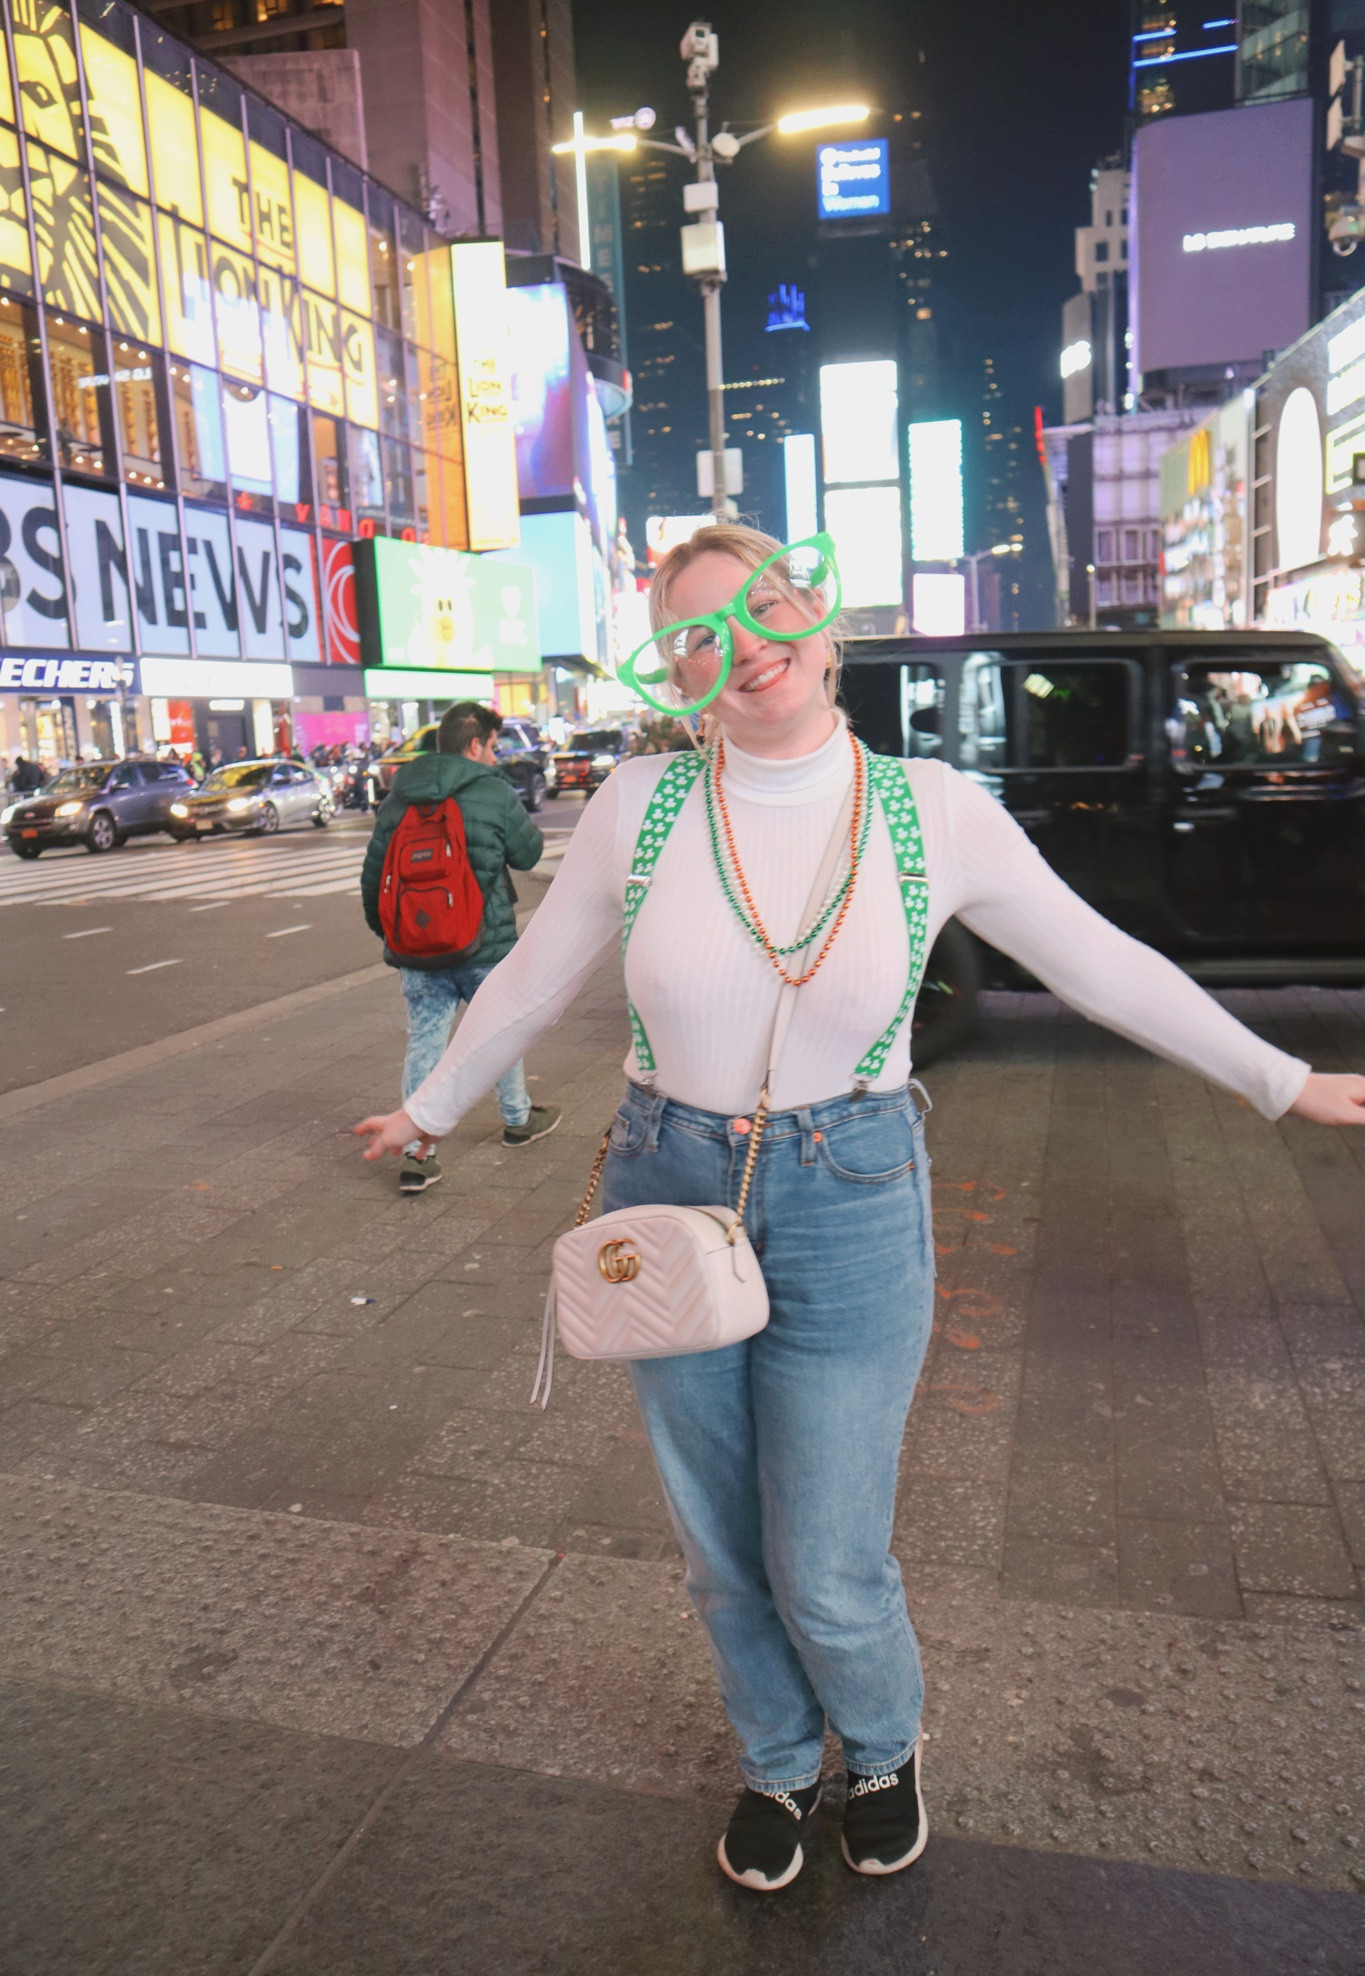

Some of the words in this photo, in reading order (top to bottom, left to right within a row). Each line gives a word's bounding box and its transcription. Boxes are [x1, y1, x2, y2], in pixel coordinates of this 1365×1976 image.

[232, 176, 292, 251] THE
[170, 203, 272, 331] LION
[277, 263, 363, 374] KING
[466, 402, 508, 424] KING
[468, 377, 503, 398] LION
[95, 519, 309, 639] NEWS
[848, 1772, 899, 1800] adidas
